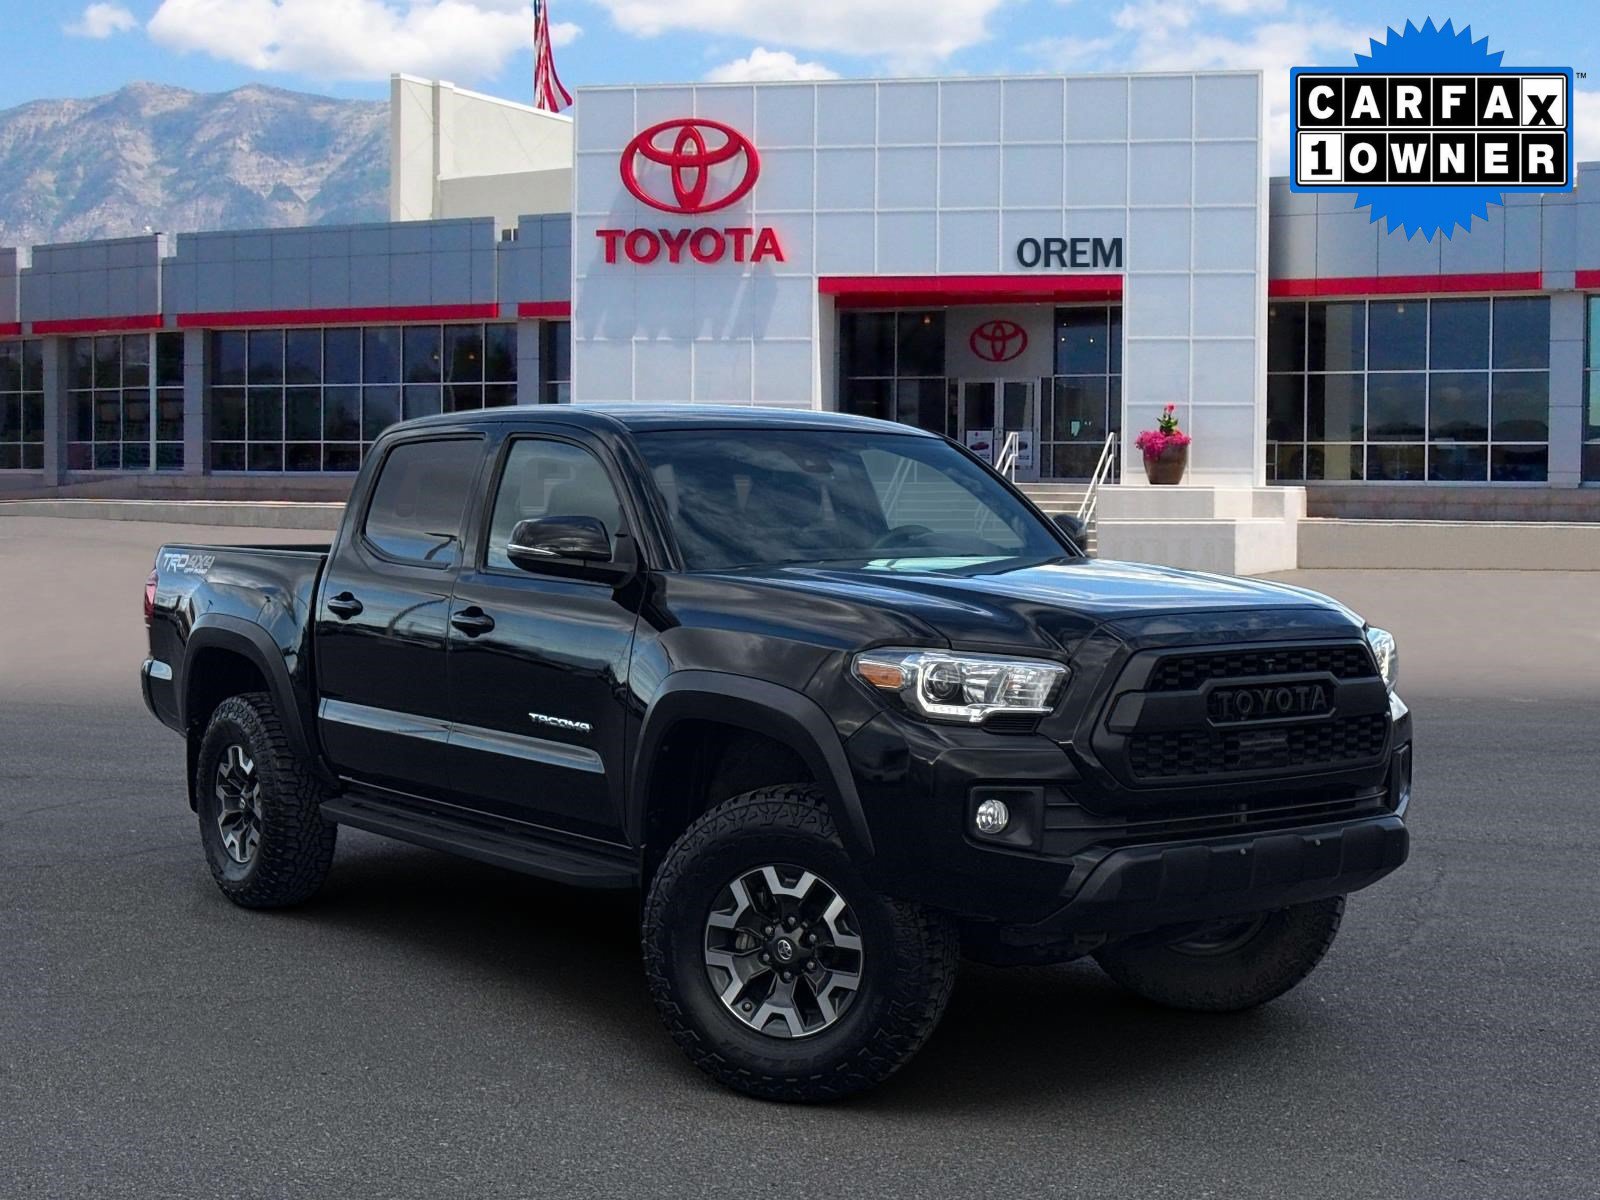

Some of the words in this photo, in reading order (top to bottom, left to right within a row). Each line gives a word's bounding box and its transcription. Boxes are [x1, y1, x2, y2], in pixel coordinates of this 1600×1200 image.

[596, 227, 785, 264] TOYOTA
[1016, 237, 1123, 268] OREM
[163, 553, 190, 573] TRD
[1215, 684, 1329, 718] TOYOTA
[528, 712, 592, 733] TACOMA
